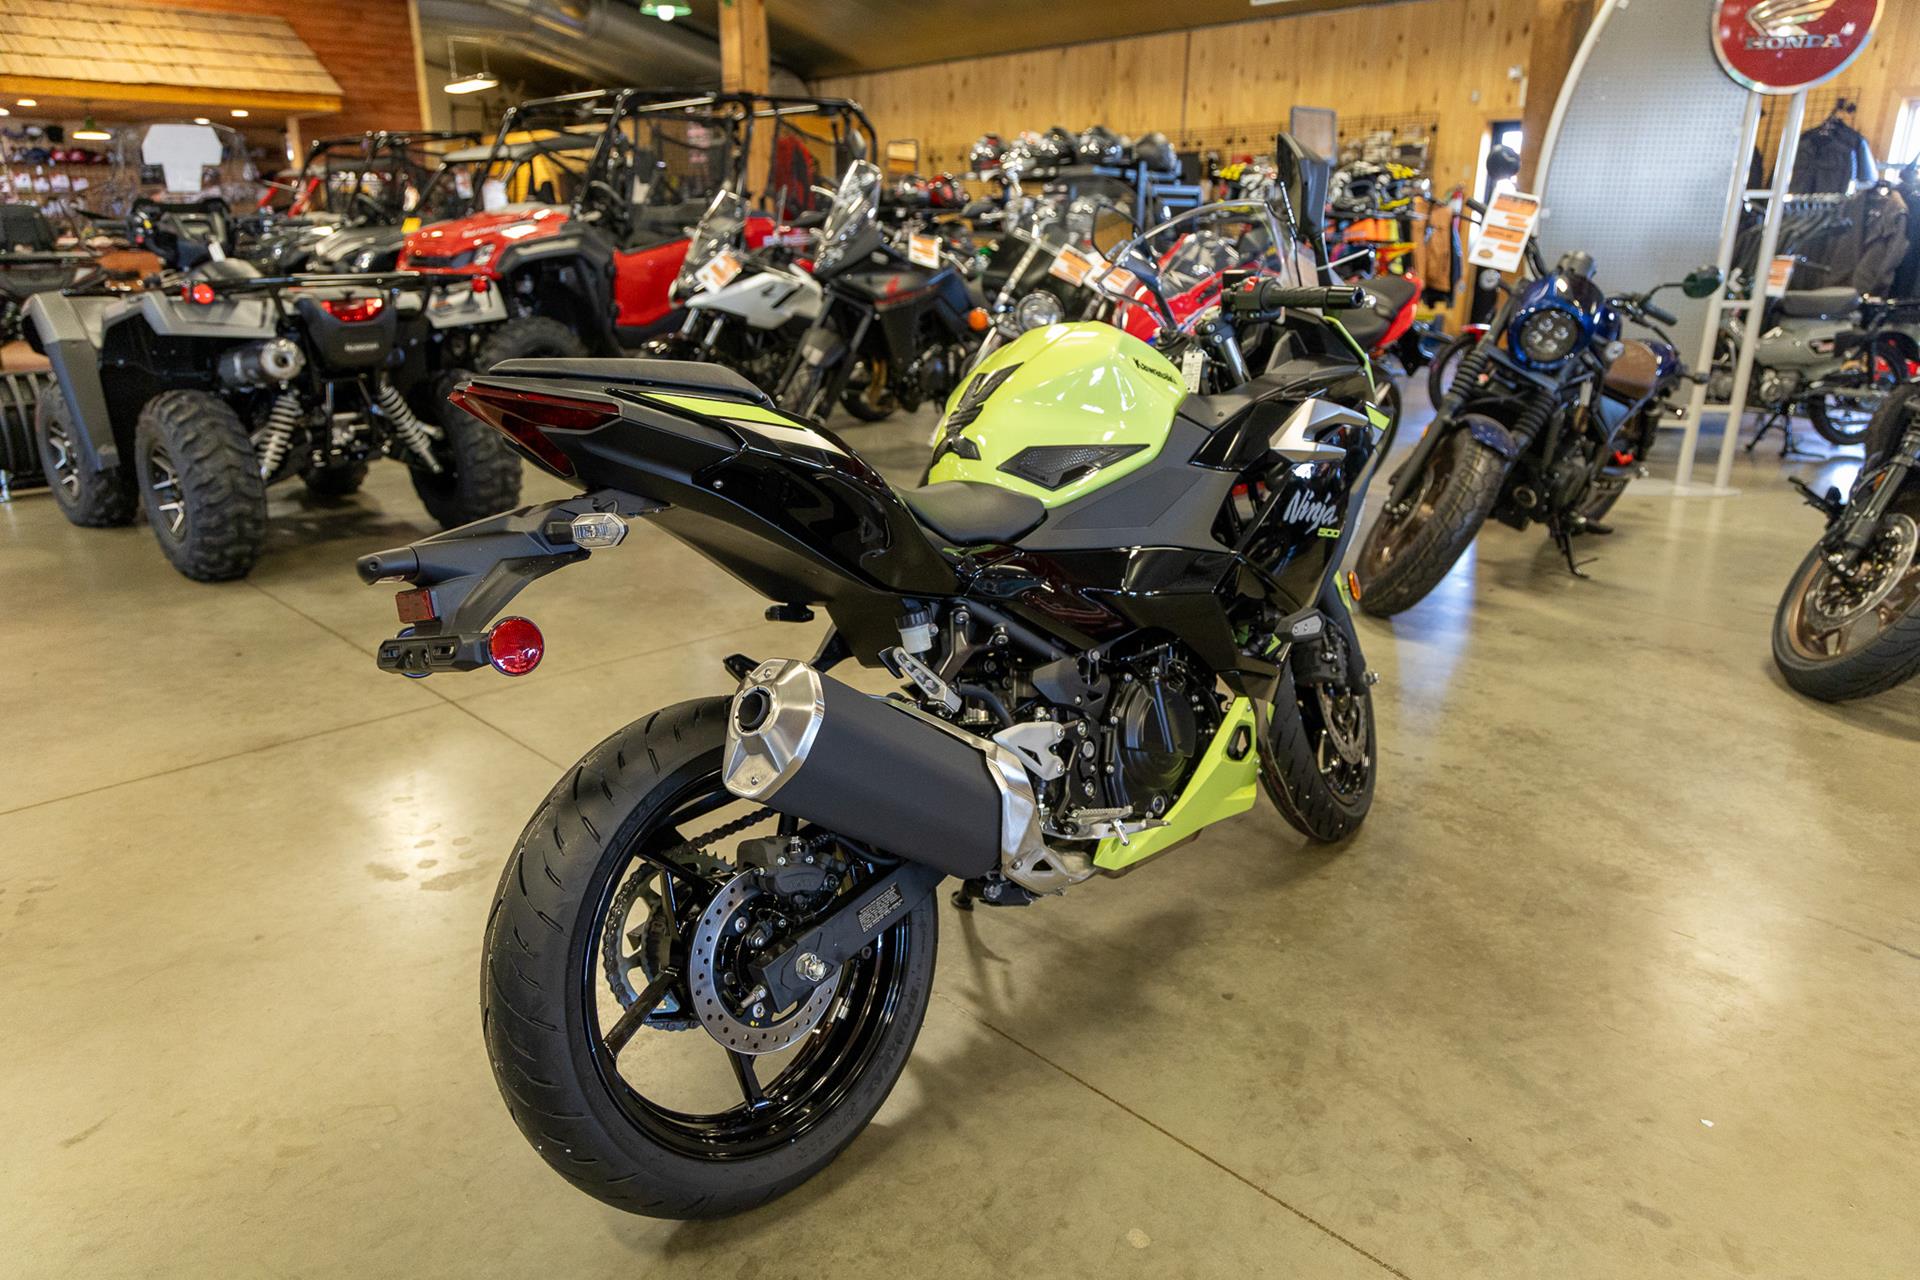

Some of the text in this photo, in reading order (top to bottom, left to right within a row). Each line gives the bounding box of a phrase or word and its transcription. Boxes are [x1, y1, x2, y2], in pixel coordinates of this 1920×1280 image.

[1745, 34, 1842, 50] HONDA
[1283, 488, 1338, 535] Ninja
[1317, 527, 1340, 538] 500
